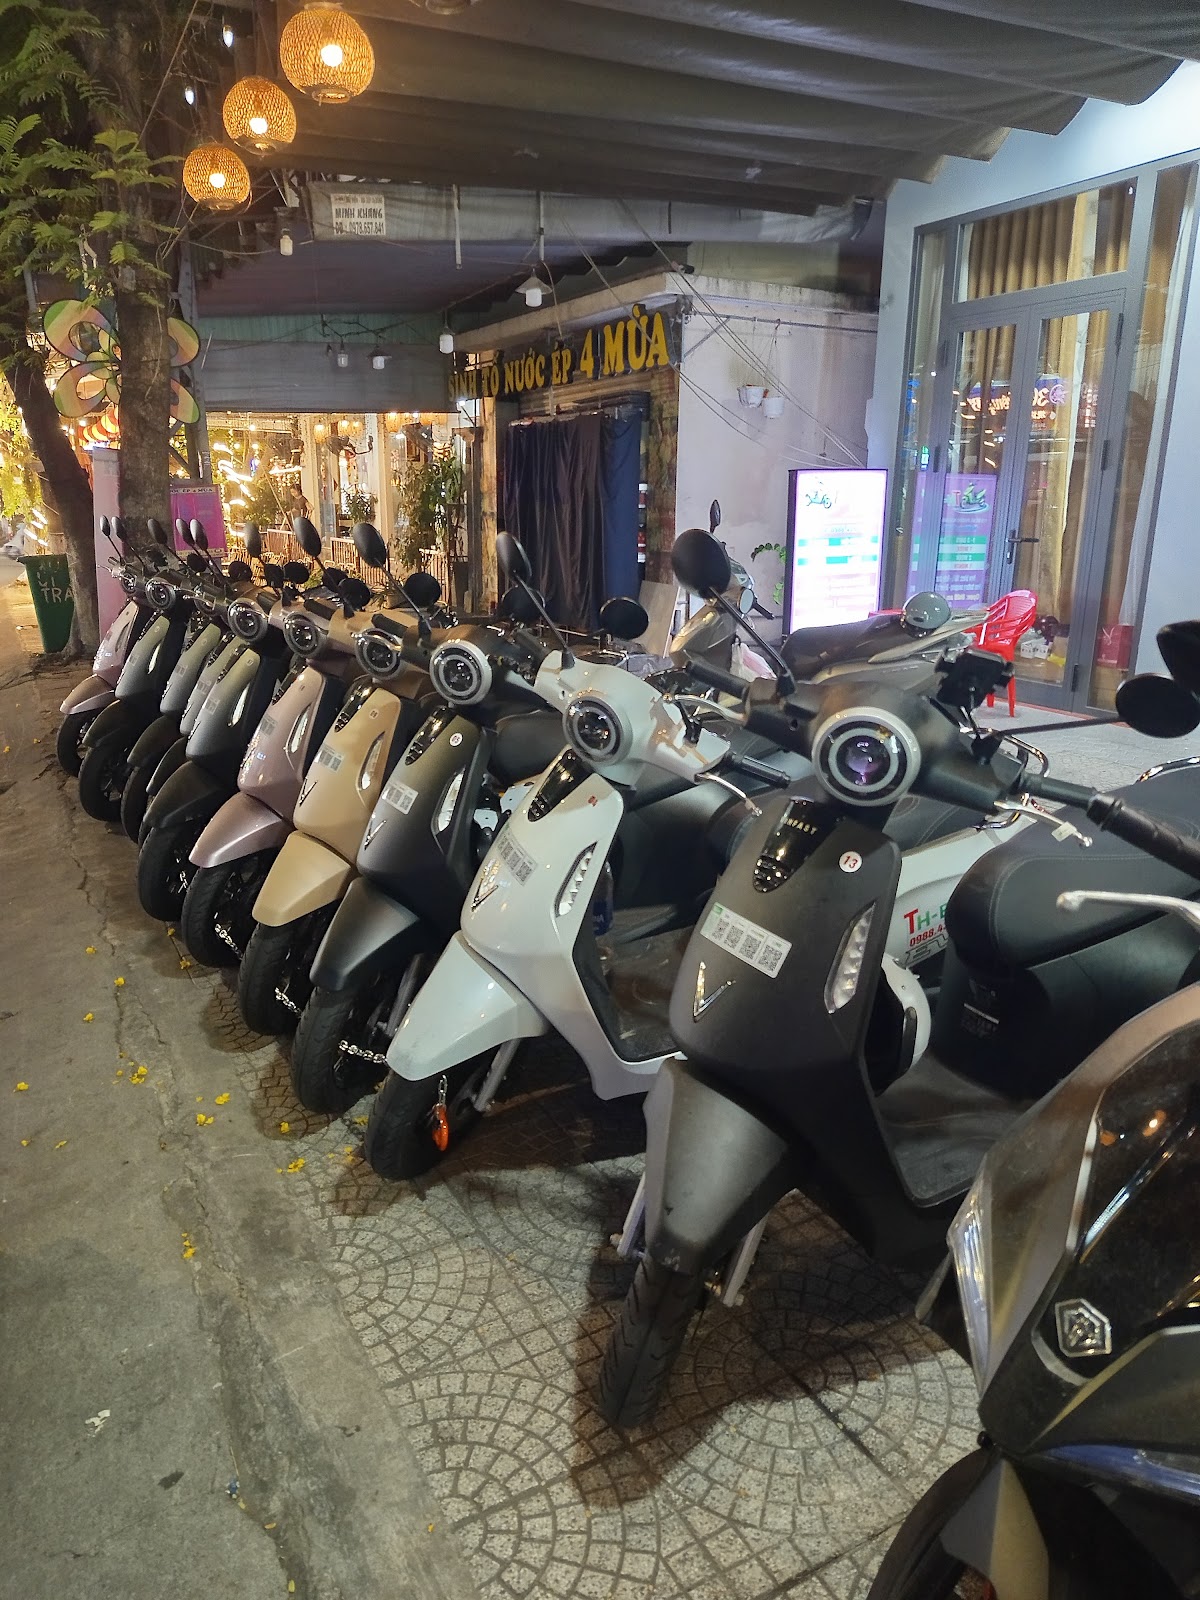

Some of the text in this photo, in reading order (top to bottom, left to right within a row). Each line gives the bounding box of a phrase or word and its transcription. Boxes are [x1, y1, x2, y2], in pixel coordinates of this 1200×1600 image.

[504, 347, 546, 394] NƯỚC
[551, 340, 571, 385] ÉP
[580, 329, 594, 379] 4
[603, 304, 669, 375] MÙA
[843, 856, 858, 869] 13
